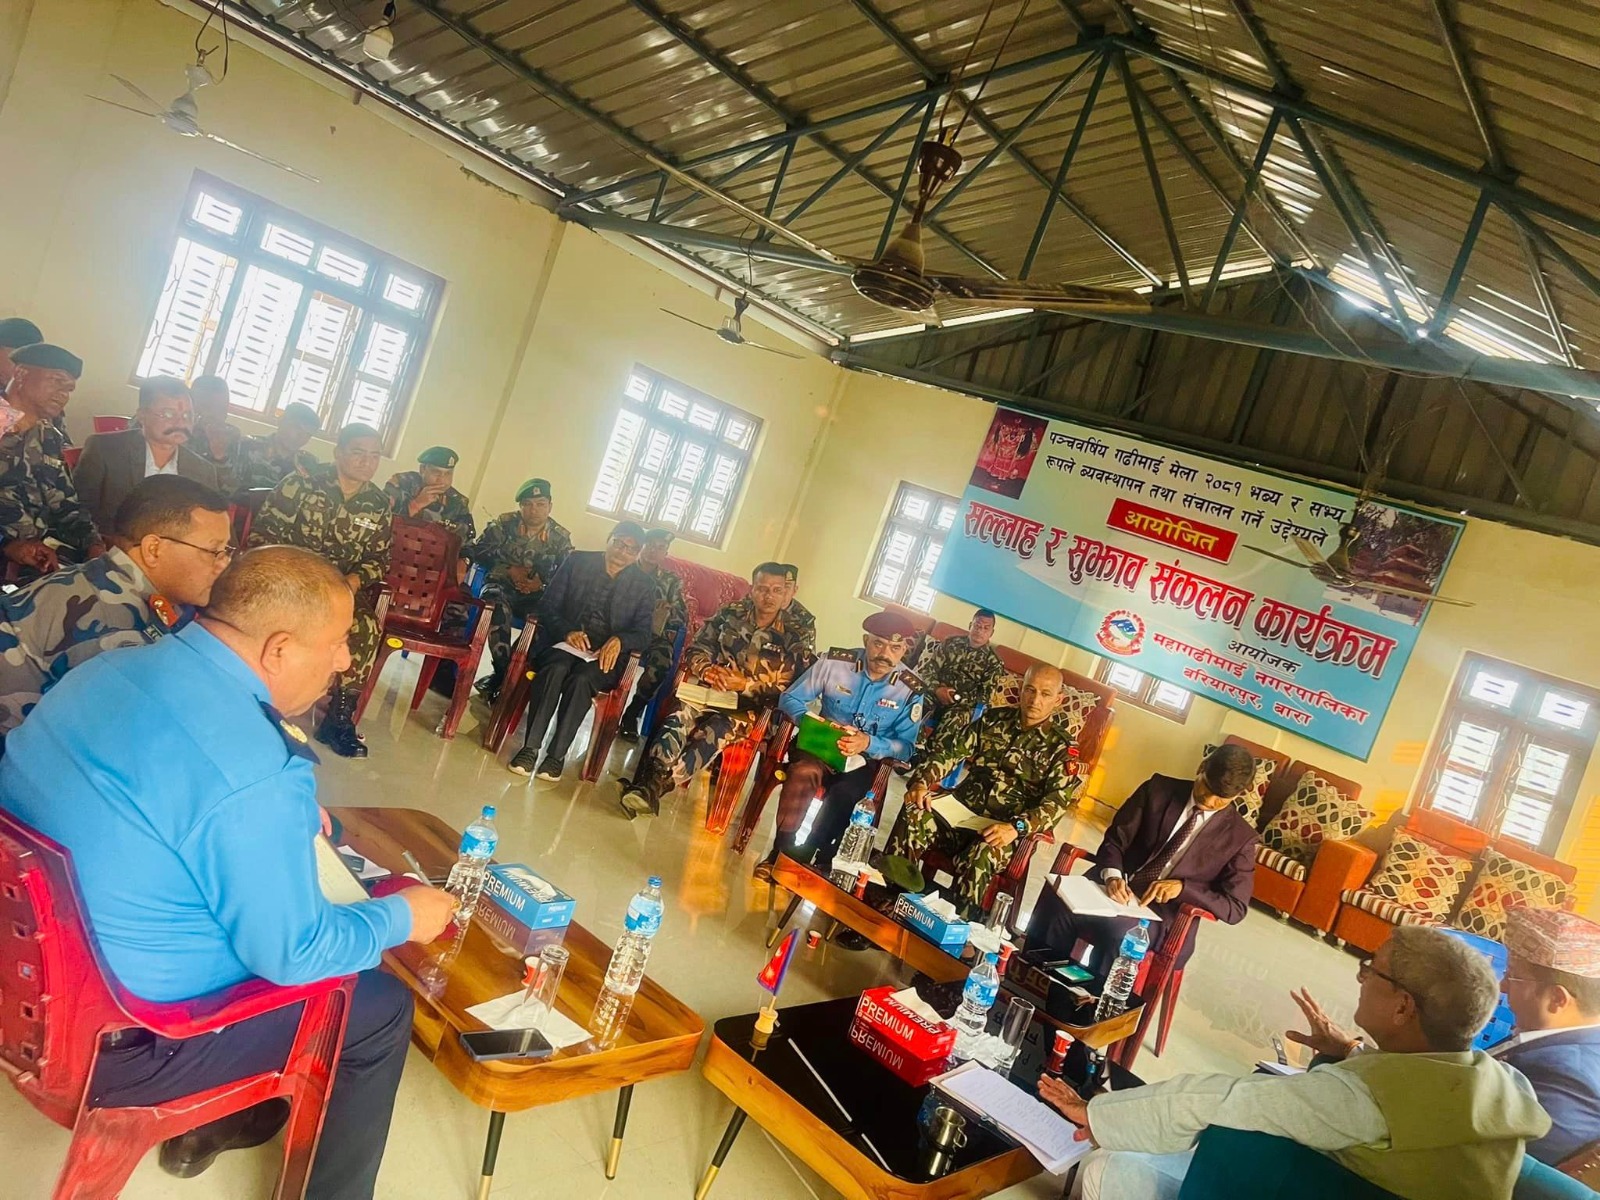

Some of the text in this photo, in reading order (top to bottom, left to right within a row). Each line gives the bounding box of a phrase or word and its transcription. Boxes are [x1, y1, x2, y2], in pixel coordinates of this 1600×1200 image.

[1045, 453, 1076, 475] रूपले
[1150, 483, 1178, 504] तथा
[1182, 491, 1234, 520] संचालन
[1241, 507, 1265, 529] गर्ने
[1115, 447, 1163, 475] गढीमाई
[1170, 460, 1198, 482] मेला
[1205, 473, 1242, 497] २०८१
[1290, 495, 1304, 513] र
[1309, 501, 1348, 523] सभ्य
[1124, 509, 1220, 552] आयोजित
[962, 499, 1042, 560] सल्लाह
[1044, 528, 1068, 565] र
[1149, 556, 1256, 630] संकलन
[1254, 596, 1397, 678] कार्यक्रम
[1153, 632, 1370, 723] महागढीमाई नगरपालिका
[1227, 638, 1302, 676] आयोजक
[1274, 700, 1314, 727] बारा
[483, 871, 526, 912] PREMIUM
[897, 898, 936, 930] PREMIUM
[860, 996, 915, 1041] PREMIUM
[883, 997, 942, 1034] PREMIUM
